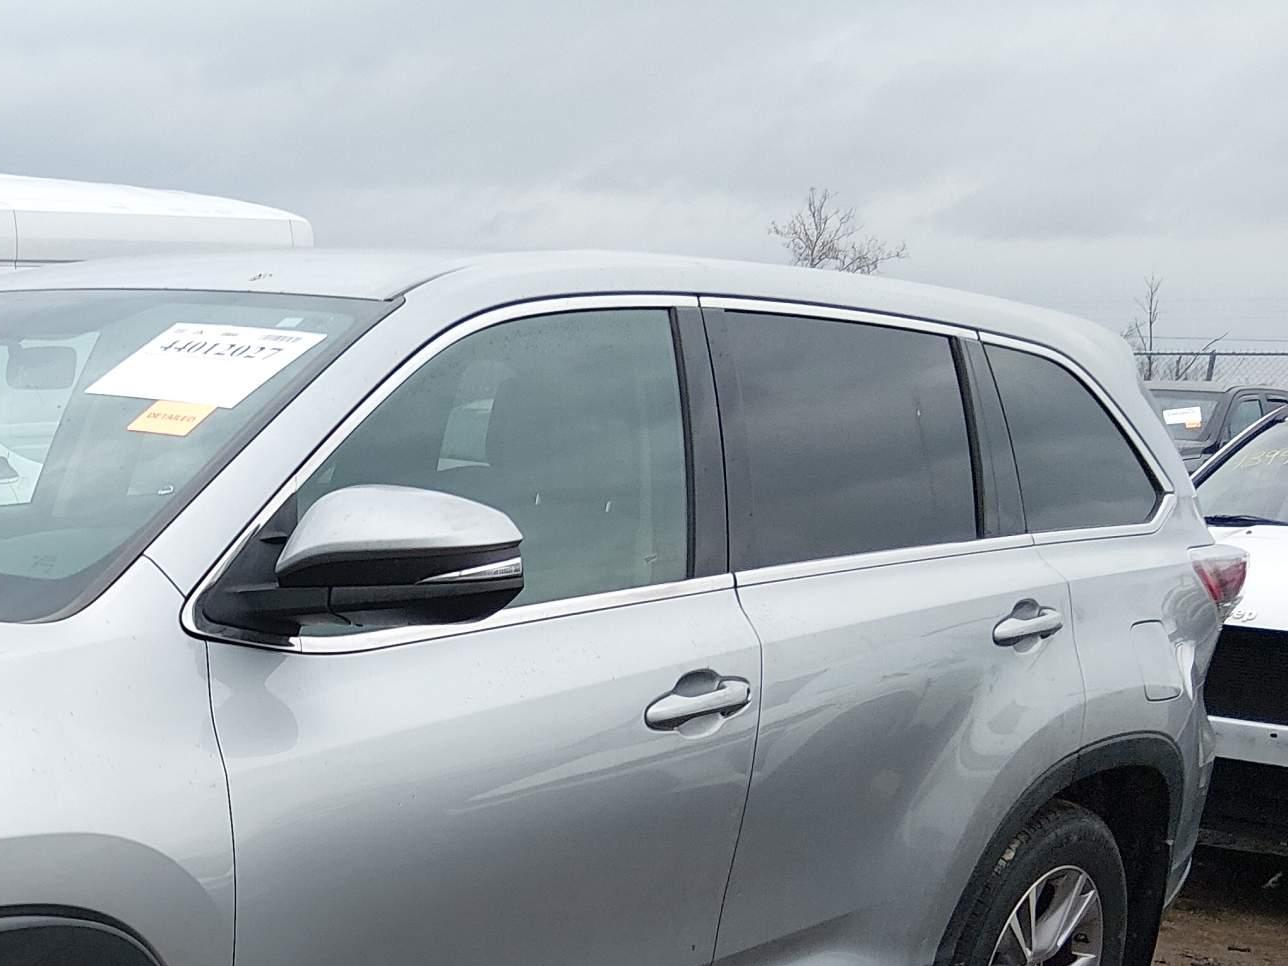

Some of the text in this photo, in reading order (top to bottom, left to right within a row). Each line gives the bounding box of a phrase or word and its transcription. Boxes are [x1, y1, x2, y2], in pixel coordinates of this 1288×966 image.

[160, 339, 284, 360] 44012027
[146, 411, 197, 423] DETAILED
[1232, 608, 1258, 623] ep
